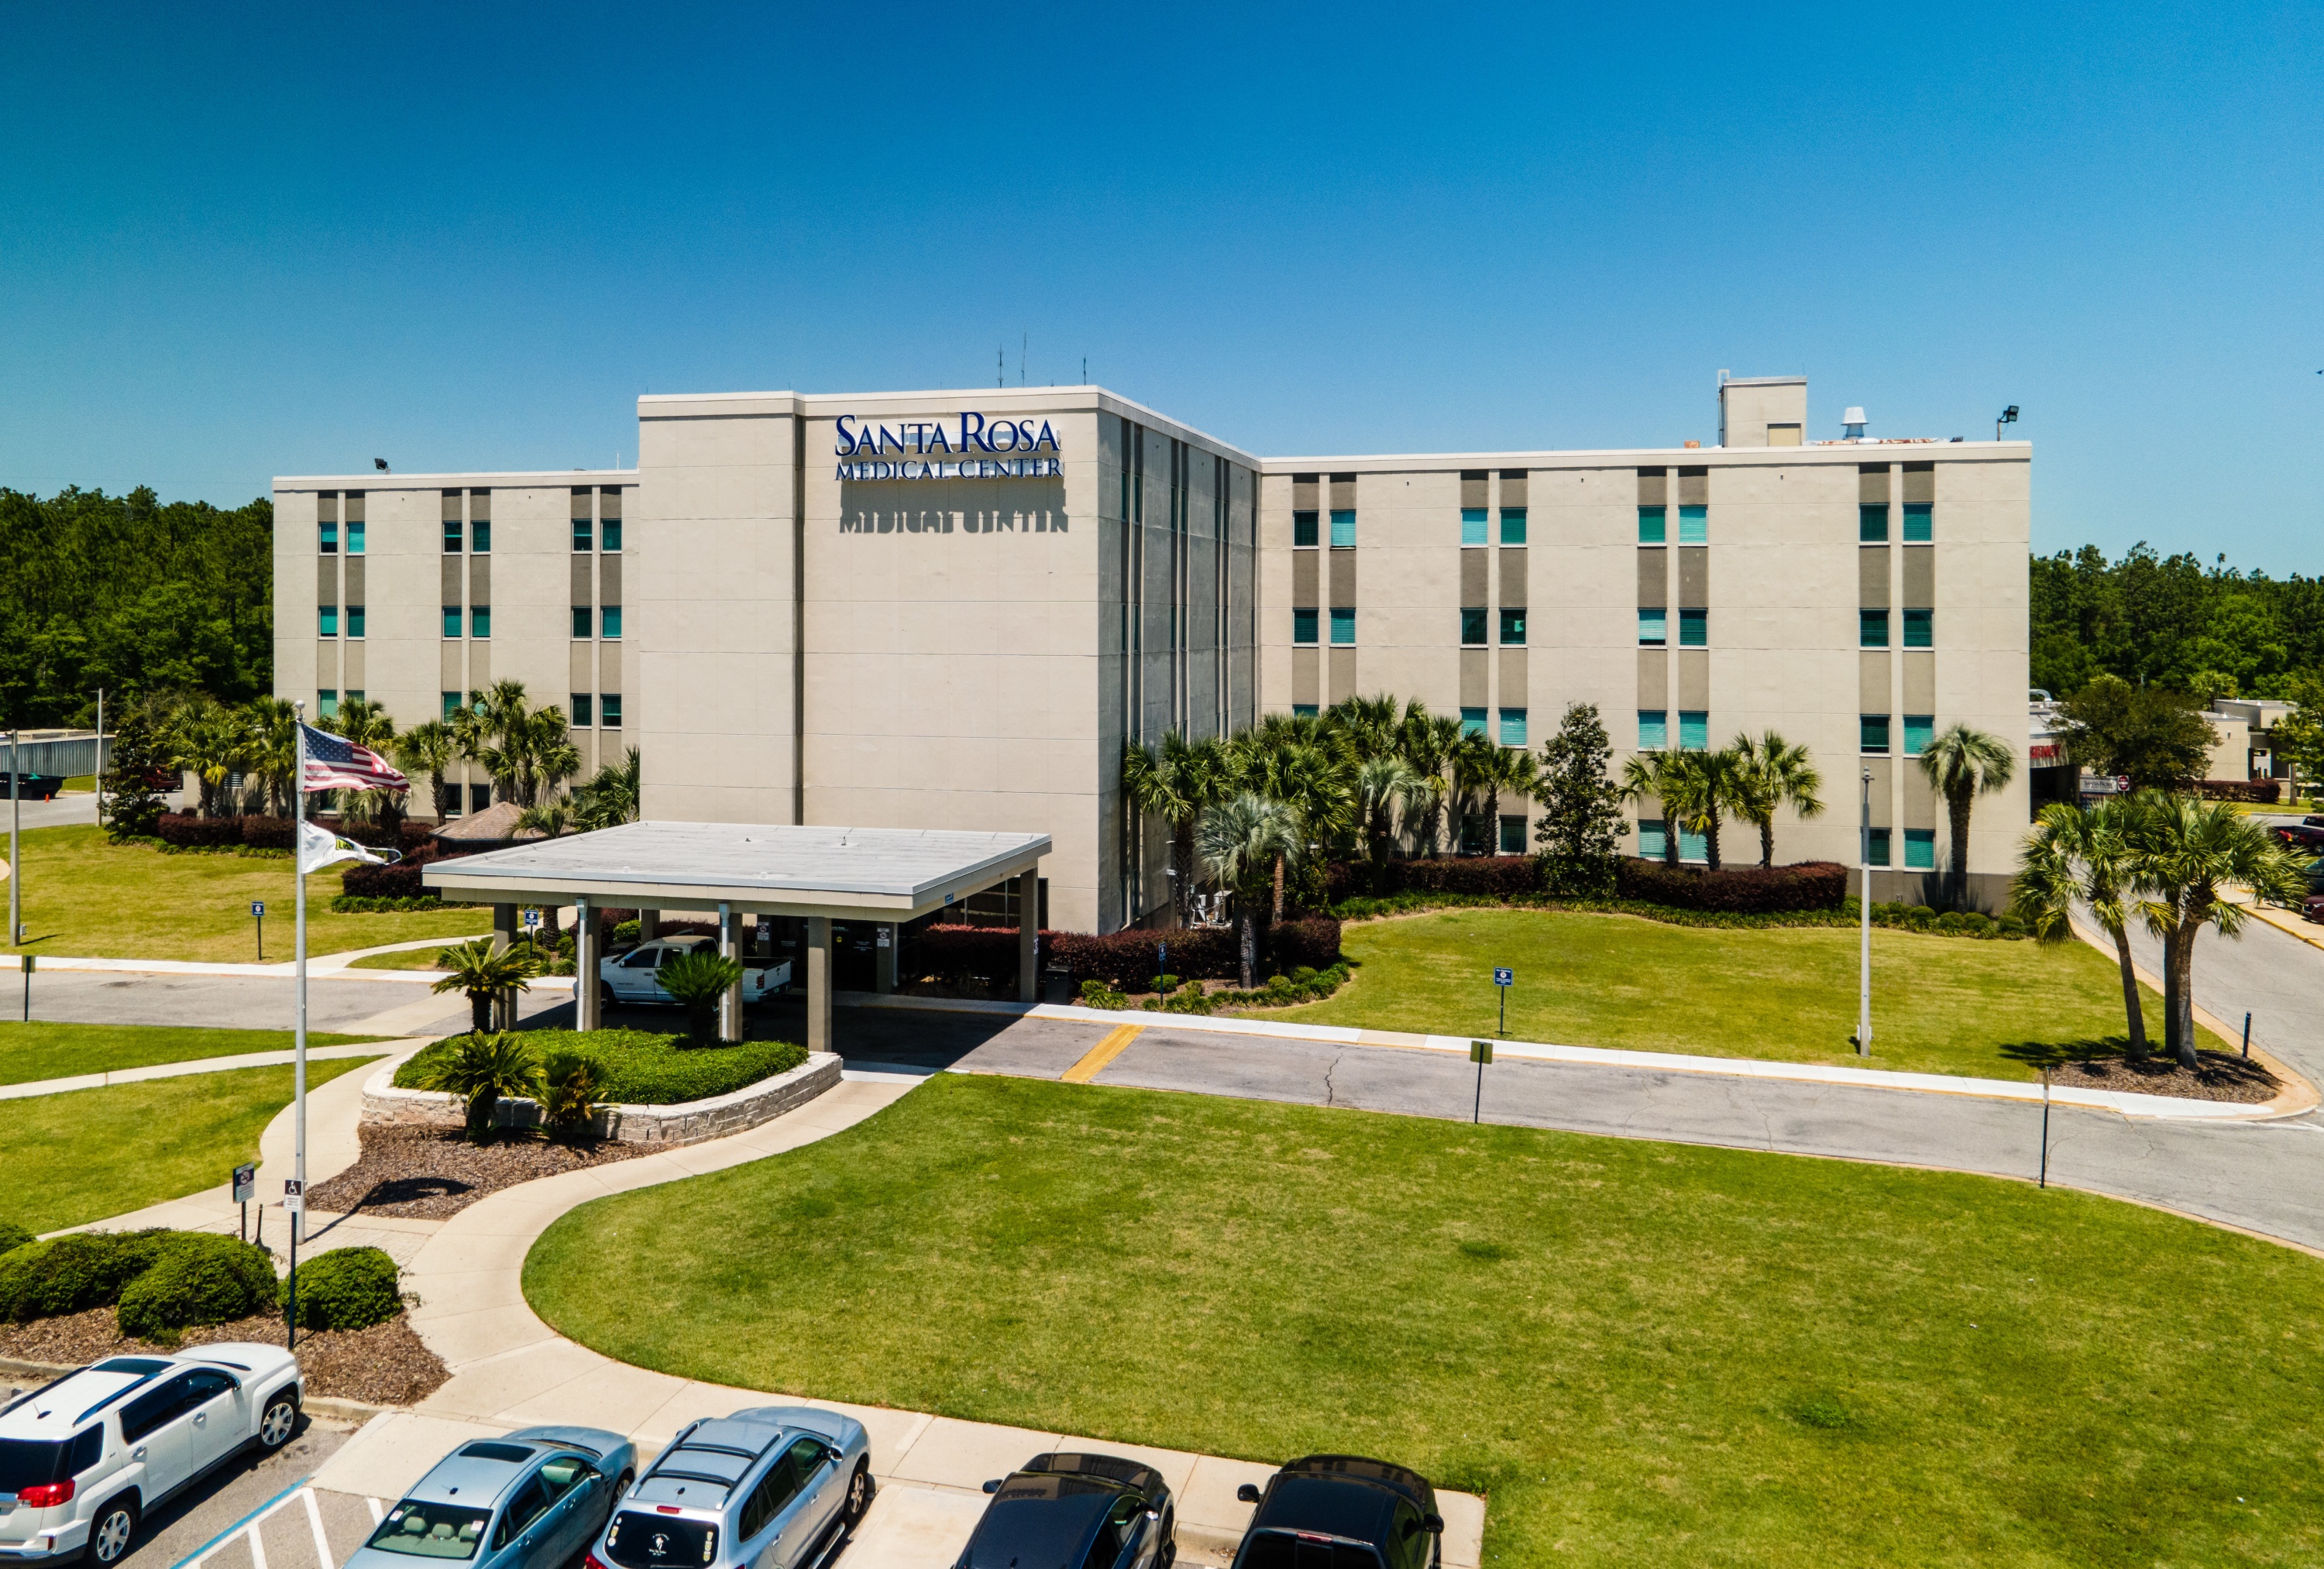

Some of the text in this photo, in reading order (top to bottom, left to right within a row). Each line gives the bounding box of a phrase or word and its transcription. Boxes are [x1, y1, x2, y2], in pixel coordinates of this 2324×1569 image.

[835, 411, 1062, 457] SANTA ROSA
[834, 458, 1065, 482] MEDICAL CENTER
